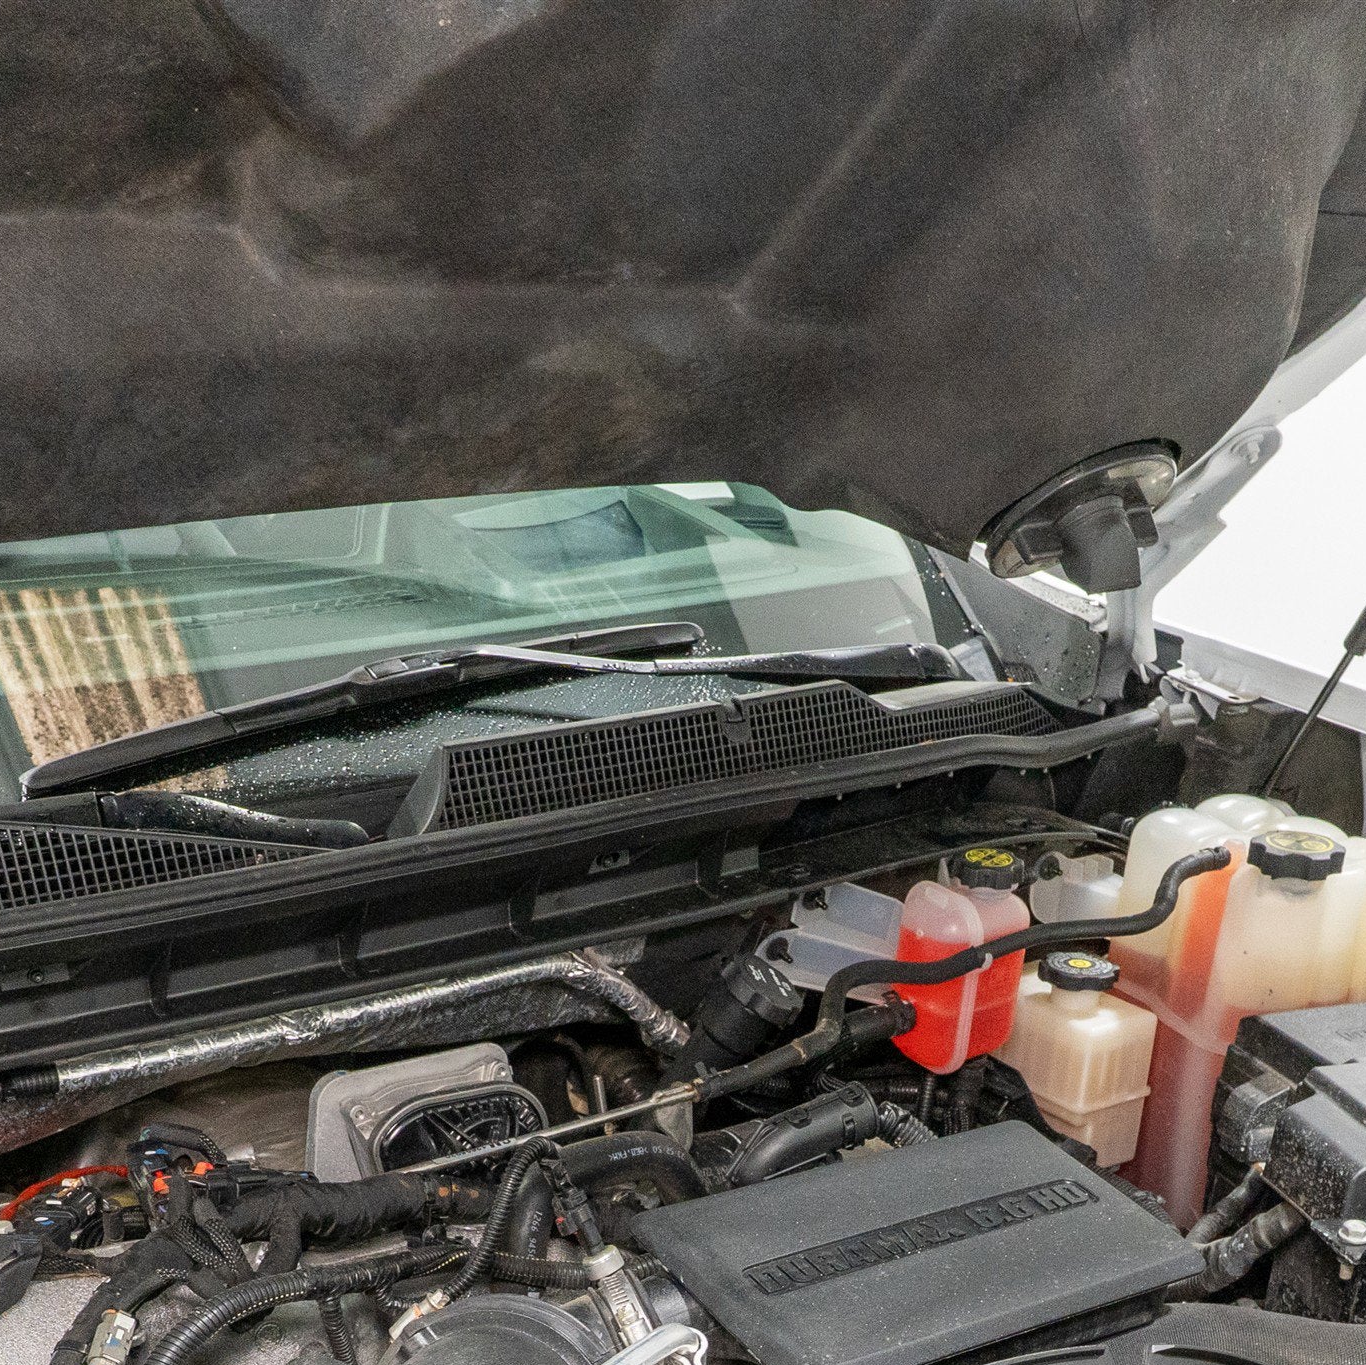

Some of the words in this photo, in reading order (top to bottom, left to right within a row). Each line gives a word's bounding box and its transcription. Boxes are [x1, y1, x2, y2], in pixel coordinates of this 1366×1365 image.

[531, 1211, 543, 1232] 1266
[747, 1217, 967, 1294] DURAMAX
[1033, 1181, 1092, 1212] HD
